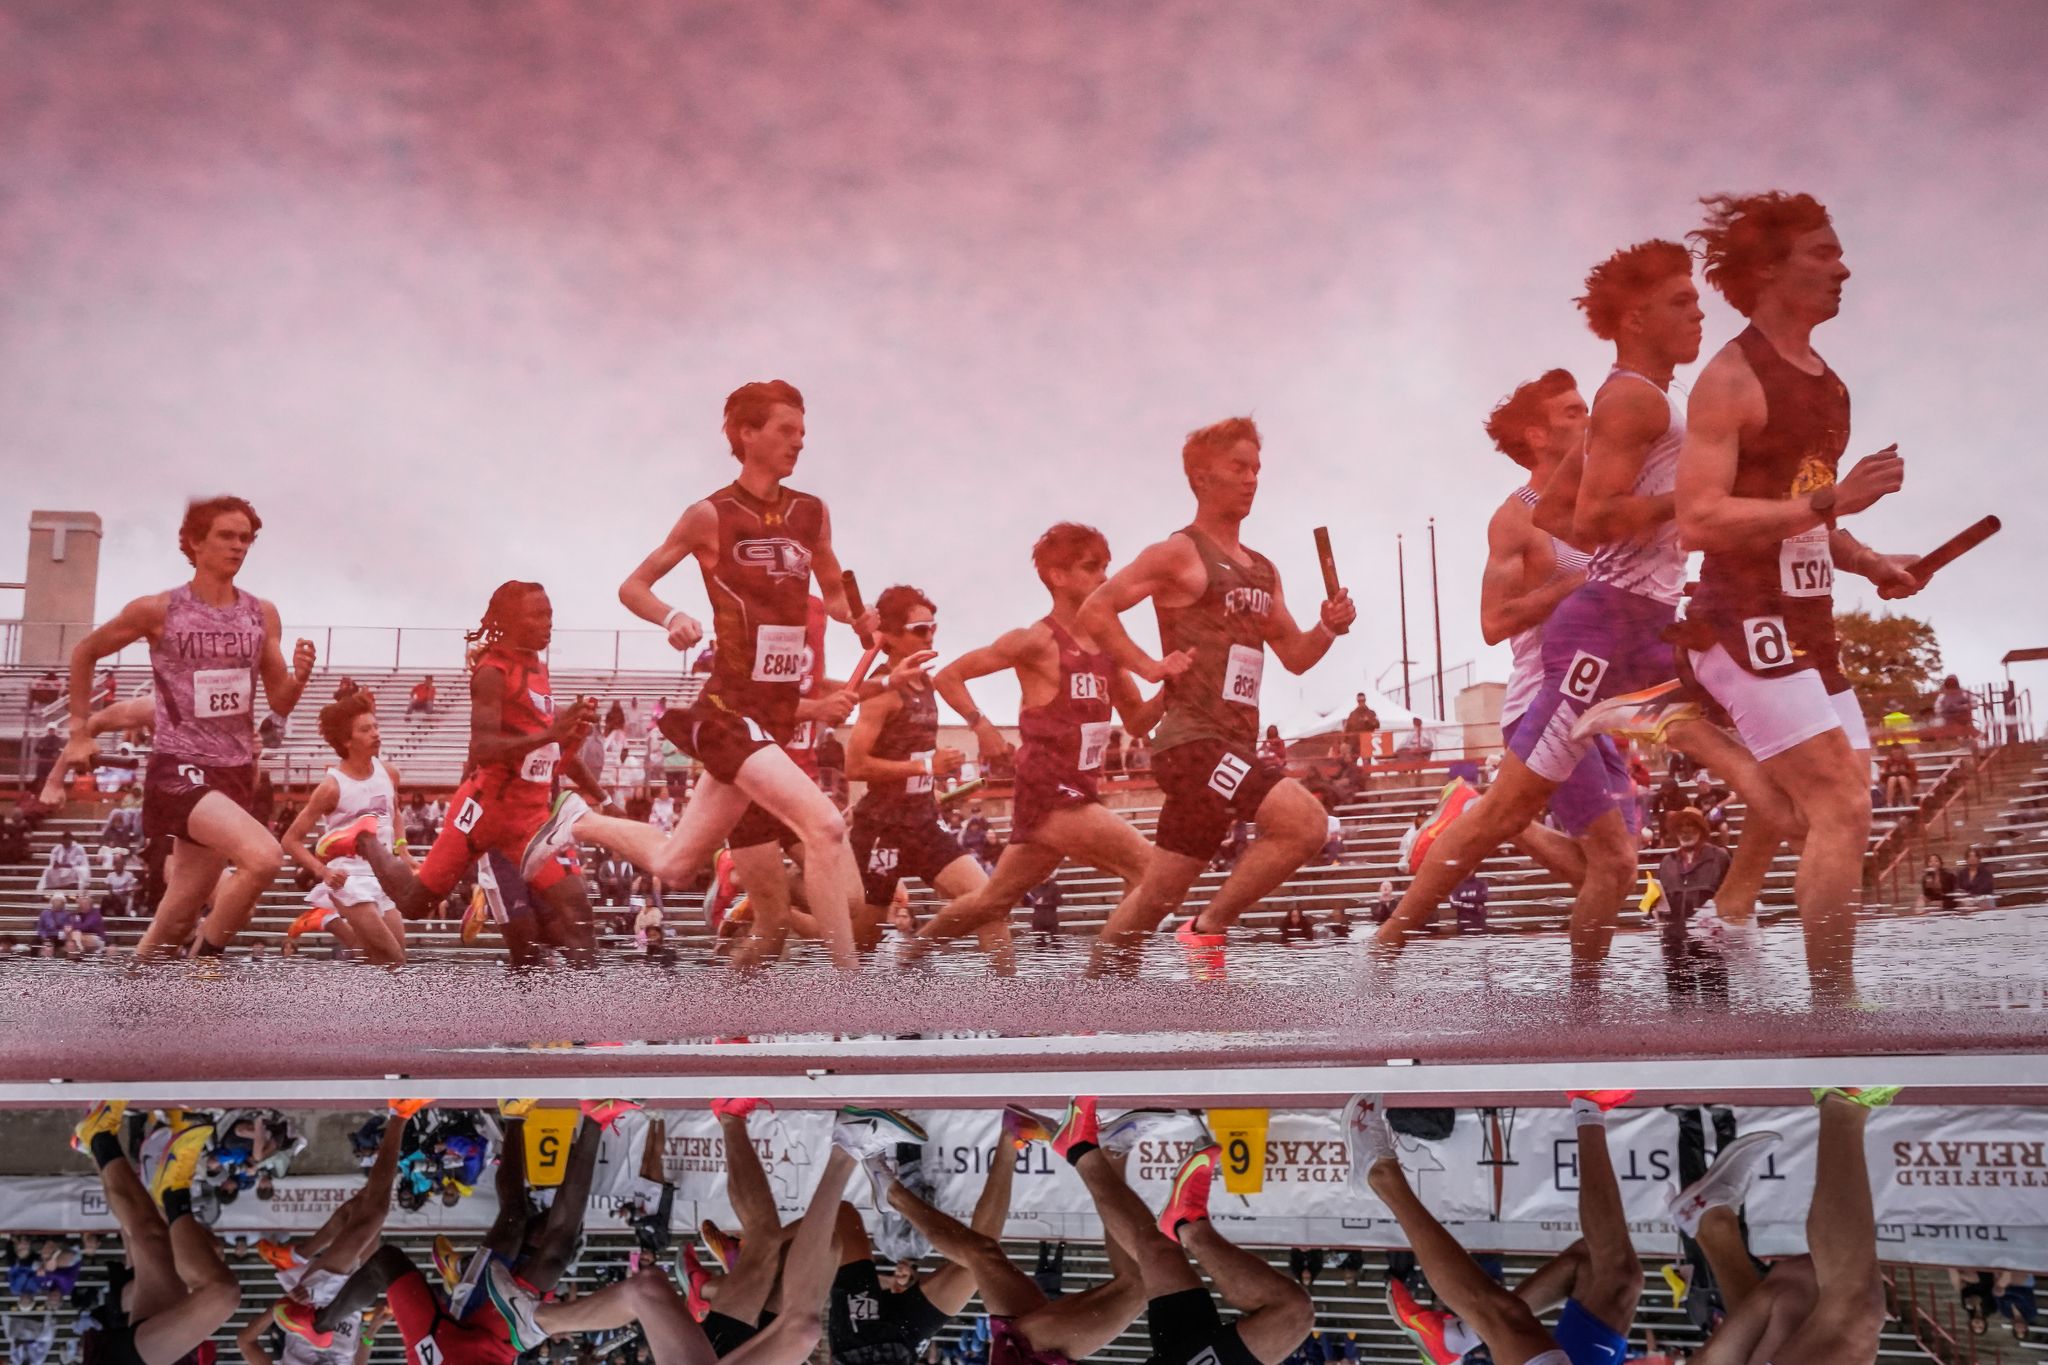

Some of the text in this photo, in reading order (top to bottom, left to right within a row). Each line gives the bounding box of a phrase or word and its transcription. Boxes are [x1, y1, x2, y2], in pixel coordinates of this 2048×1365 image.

[539, 1136, 560, 1167] 5
[1229, 1138, 1251, 1174] 6
[1265, 1142, 1349, 1165] EXAS
[1894, 1140, 2045, 1167] RELAYS
[420, 1343, 434, 1365] 4
